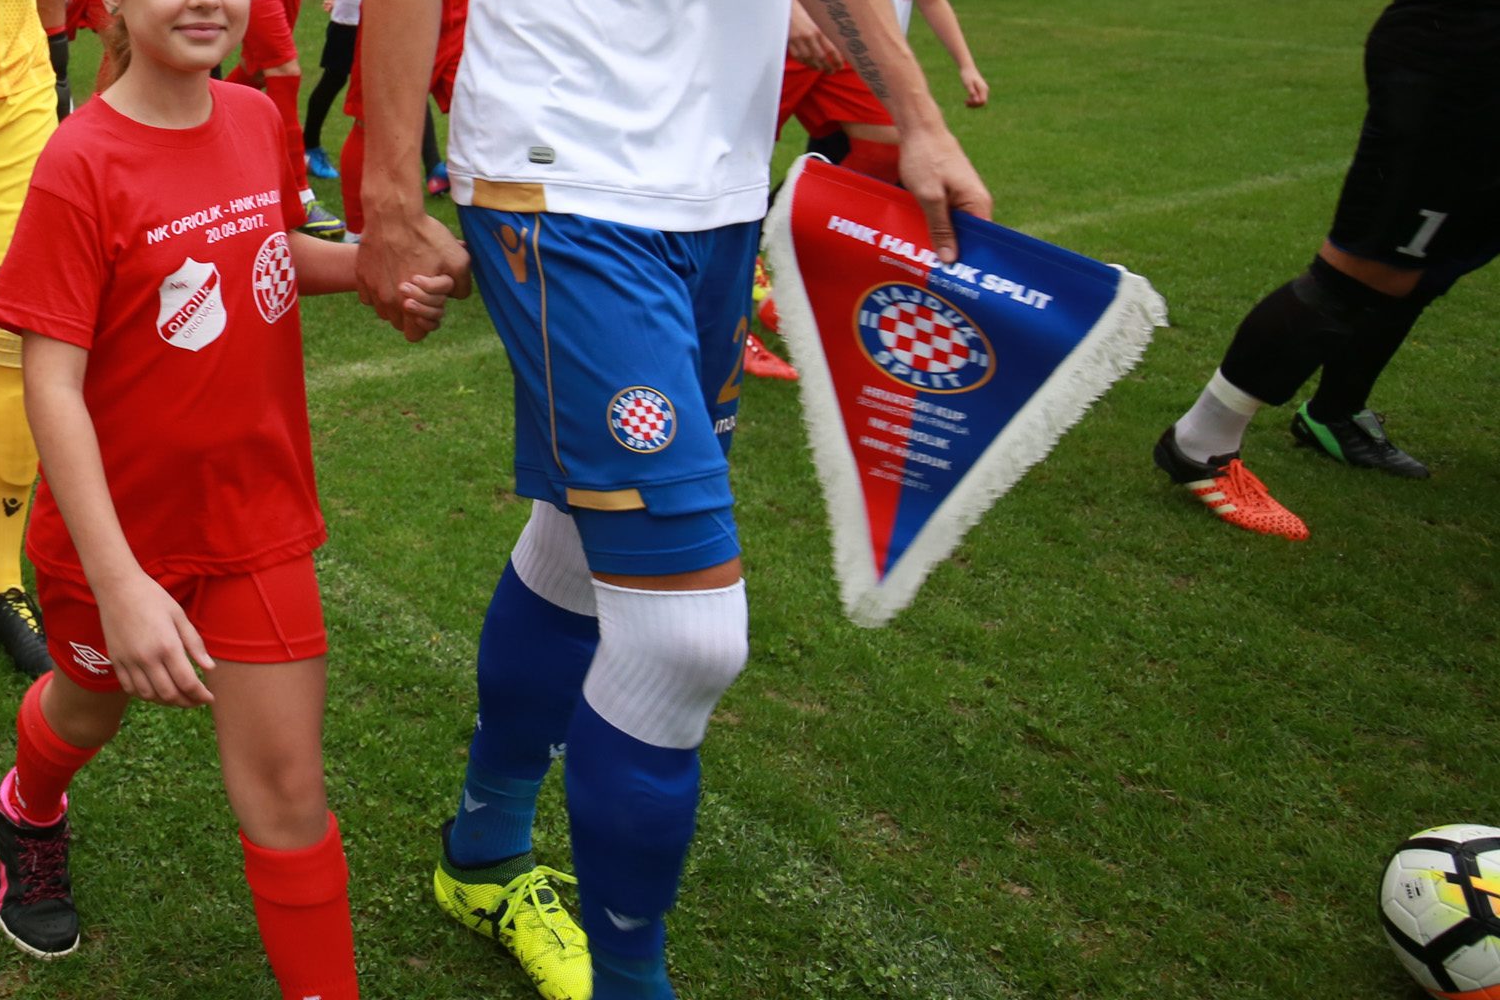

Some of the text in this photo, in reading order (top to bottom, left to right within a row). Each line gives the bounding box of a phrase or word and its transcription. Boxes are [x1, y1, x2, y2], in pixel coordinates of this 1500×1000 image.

[146, 224, 171, 245] NK
[171, 204, 223, 235] ORIOLIK
[229, 195, 257, 214] HNK
[205, 213, 269, 244] 20.09.2017.
[1395, 208, 1449, 258] 1
[827, 214, 881, 246] HNK
[978, 273, 1054, 310] SPLIT
[167, 285, 212, 334] oriolik
[870, 286, 981, 340] HAJDUK
[873, 350, 963, 388] SPLIT
[612, 390, 665, 413] HAJDUK
[626, 432, 668, 449] SPLIT
